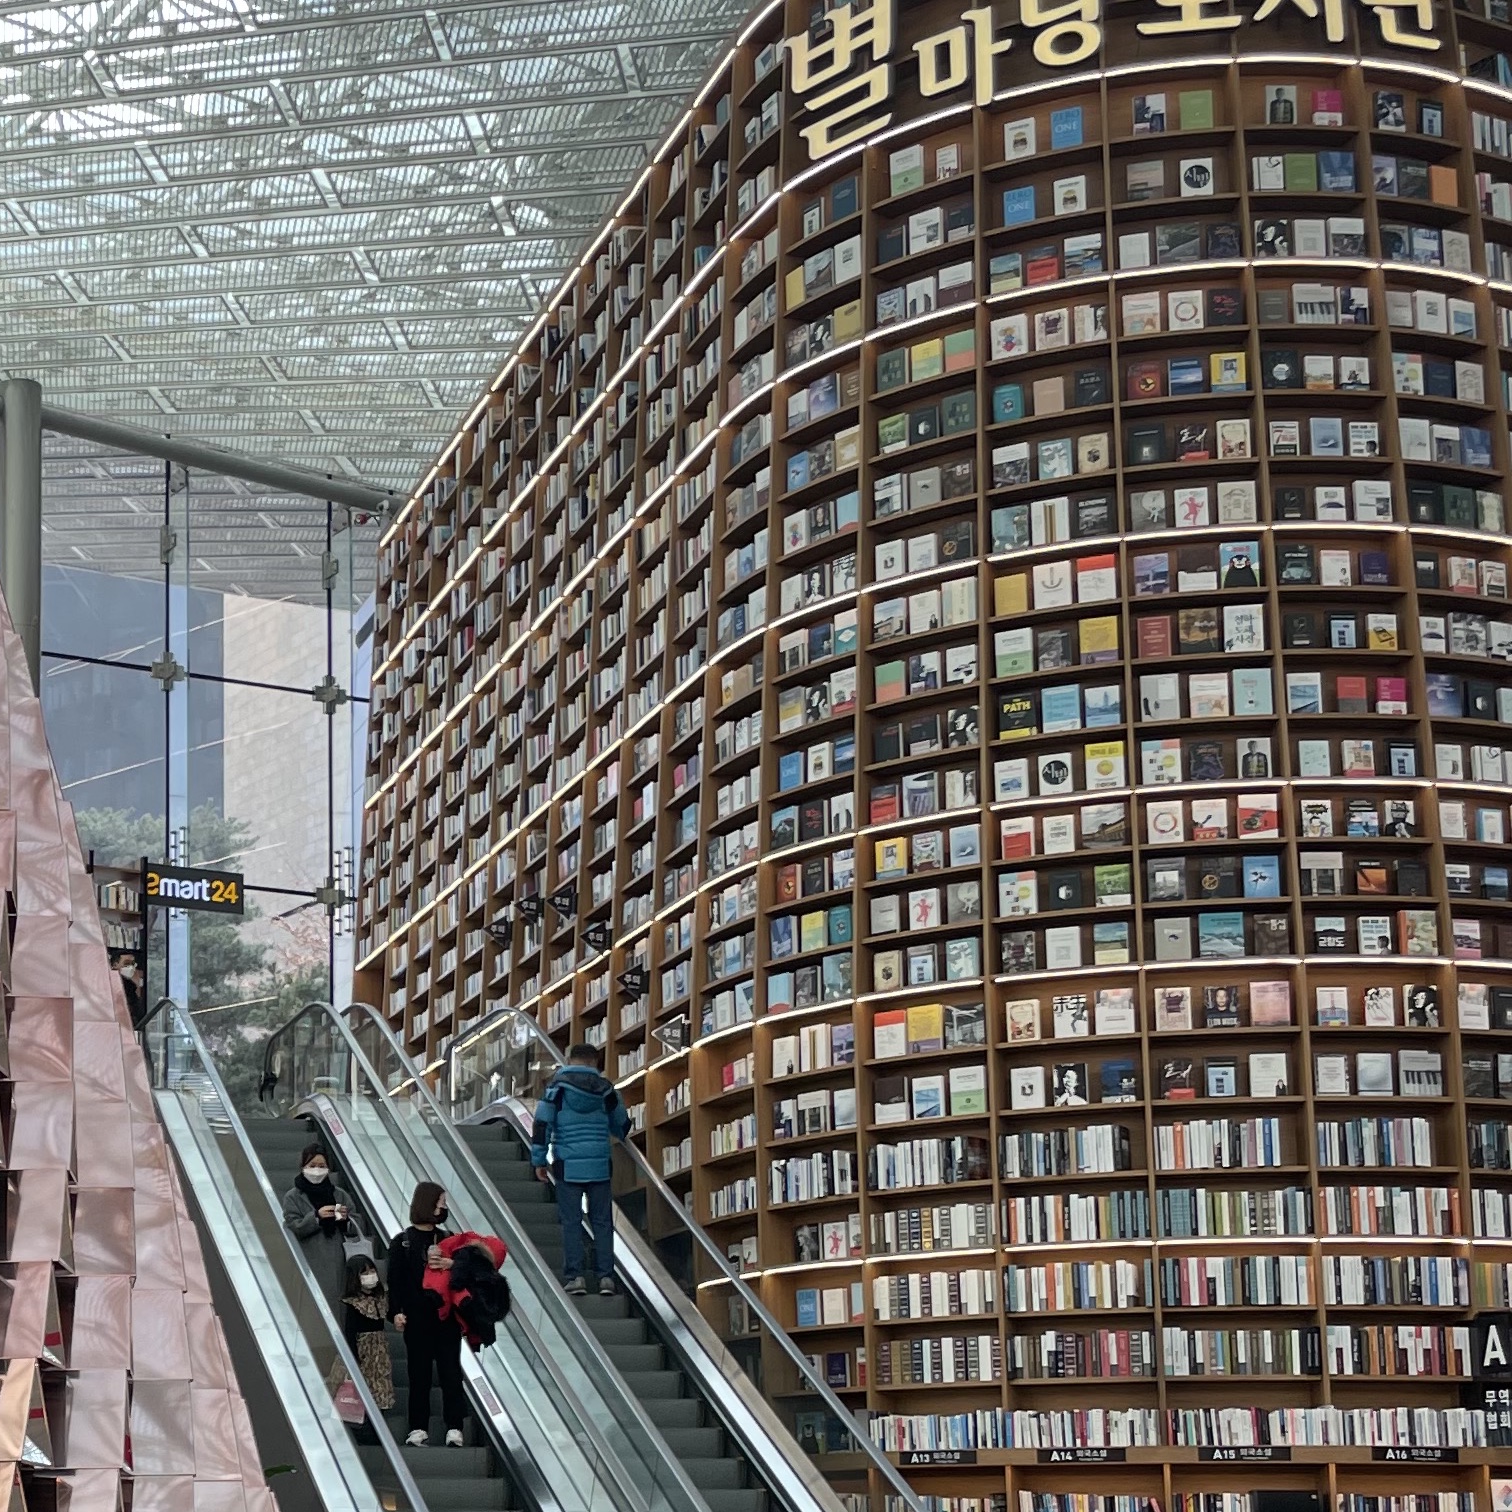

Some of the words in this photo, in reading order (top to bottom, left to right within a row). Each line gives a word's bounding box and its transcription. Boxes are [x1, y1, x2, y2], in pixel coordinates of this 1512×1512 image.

[1054, 121, 1079, 134] ONE
[1003, 700, 1031, 713] PATH
[1483, 1324, 1507, 1367] A
[910, 1453, 930, 1464] A13
[1050, 1450, 1073, 1462] A14
[1212, 1449, 1236, 1460] A15
[1385, 1448, 1408, 1460] A16
